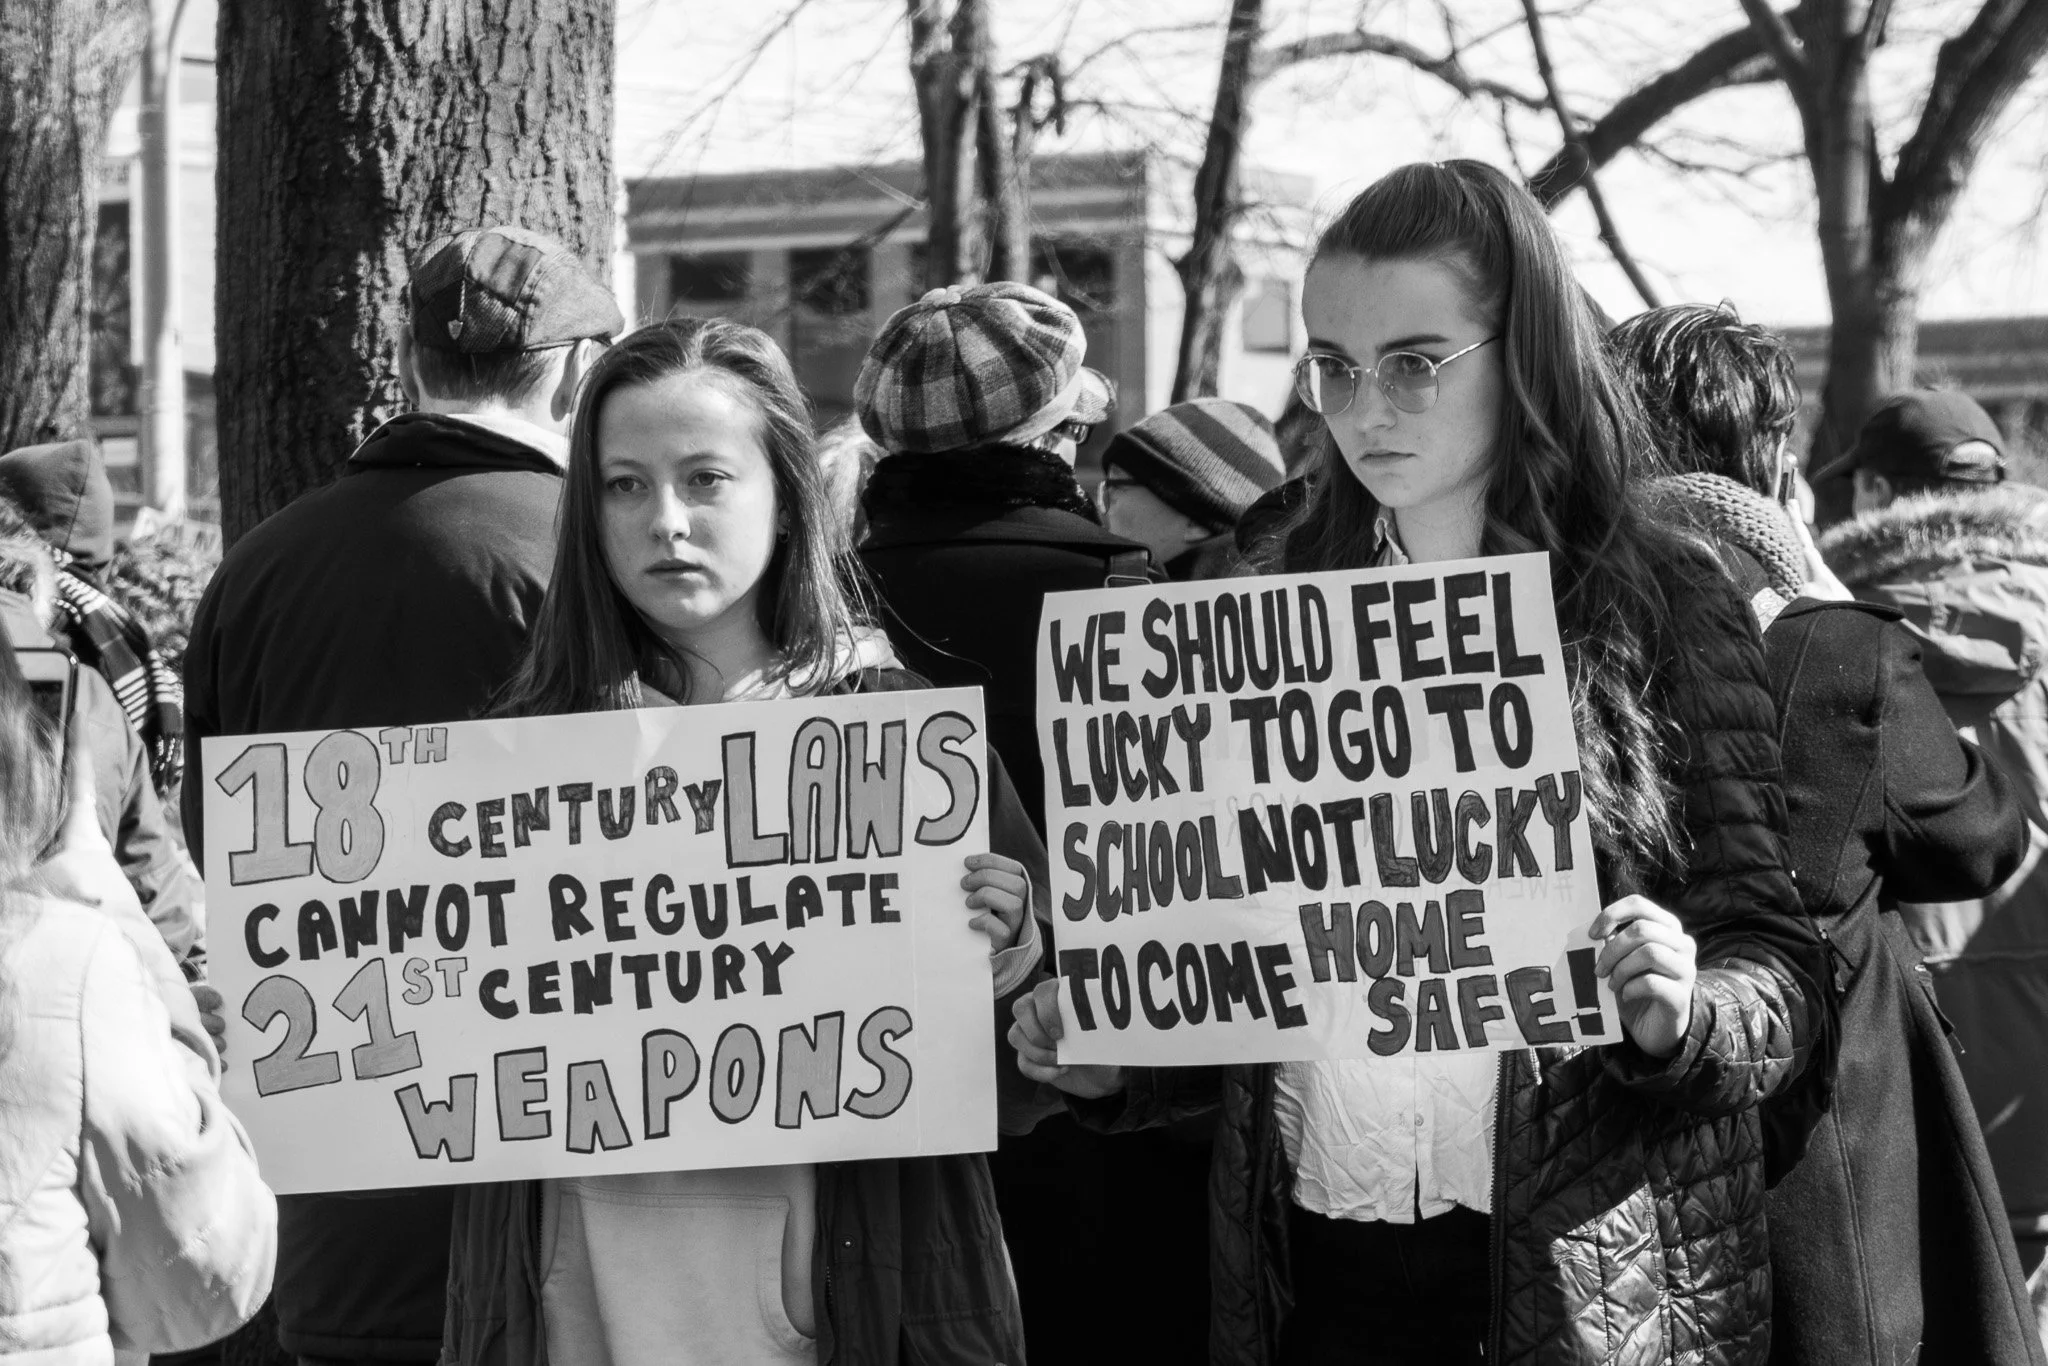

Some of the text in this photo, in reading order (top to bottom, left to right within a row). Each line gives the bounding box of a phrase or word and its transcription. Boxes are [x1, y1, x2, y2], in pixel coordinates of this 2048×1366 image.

[1050, 571, 1545, 706] WE SHOULD FEEL
[215, 710, 980, 886] 18TH CENTURY LAWS
[1053, 682, 1533, 808] LUCKY TO GO TO
[1062, 816, 1244, 922] SCHOOL
[1238, 796, 1365, 895] NOT
[1369, 770, 1581, 887] LUCKY
[245, 872, 902, 968] CANNOT REGULATE
[1059, 889, 1493, 1031] TO COME HOME
[241, 940, 794, 1098] 21ST CENTURY
[1367, 947, 1607, 1056] SAFE!
[394, 1005, 912, 1163] WEAPONS
